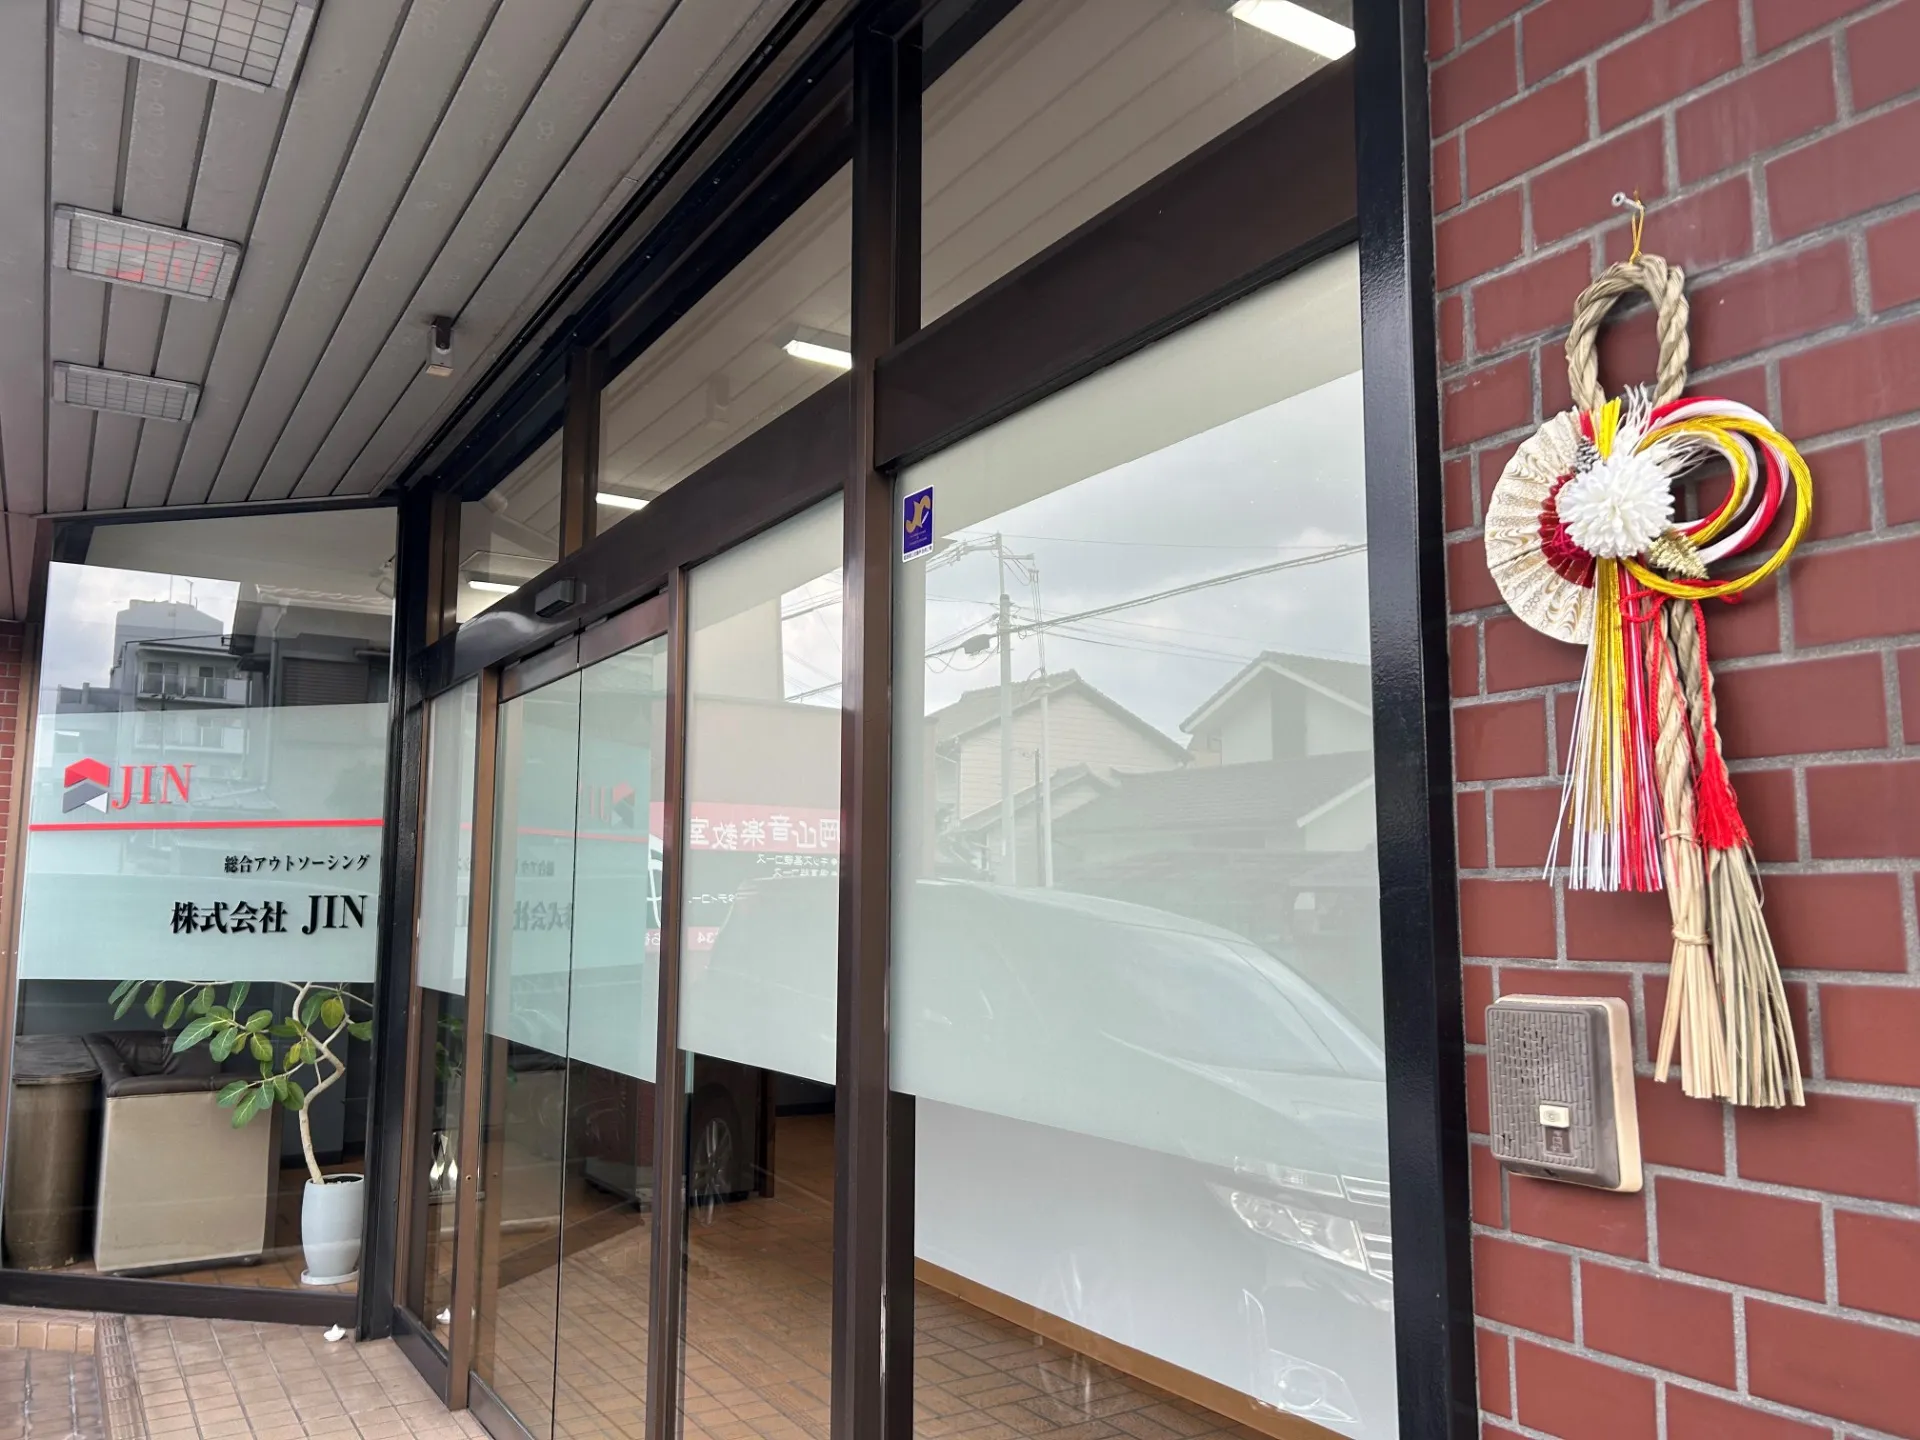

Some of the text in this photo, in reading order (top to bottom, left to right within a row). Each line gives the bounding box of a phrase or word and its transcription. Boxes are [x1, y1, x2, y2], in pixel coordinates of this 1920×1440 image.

[111, 763, 195, 810] JIN
[224, 854, 370, 874] 総合アウトソーシング
[170, 894, 368, 935] 株式会社 JIN
